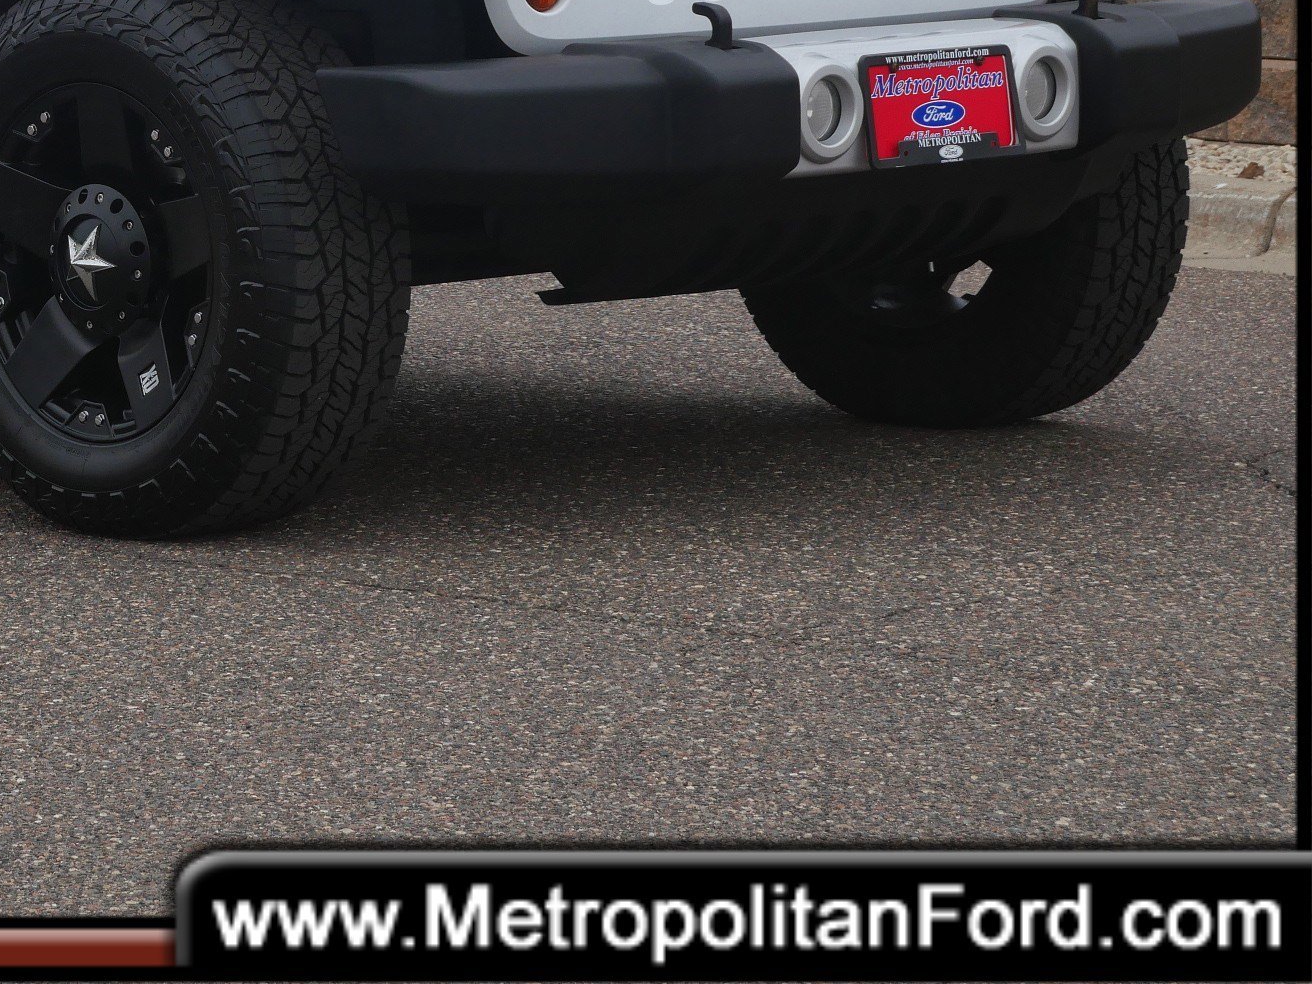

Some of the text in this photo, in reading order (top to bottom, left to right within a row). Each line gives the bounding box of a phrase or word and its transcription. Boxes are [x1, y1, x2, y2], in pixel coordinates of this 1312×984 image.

[885, 48, 989, 64] www.metropolitanford.com
[871, 66, 1003, 100] Metropolitan
[923, 105, 954, 122] Ford
[918, 133, 982, 148] METROPOLITAN
